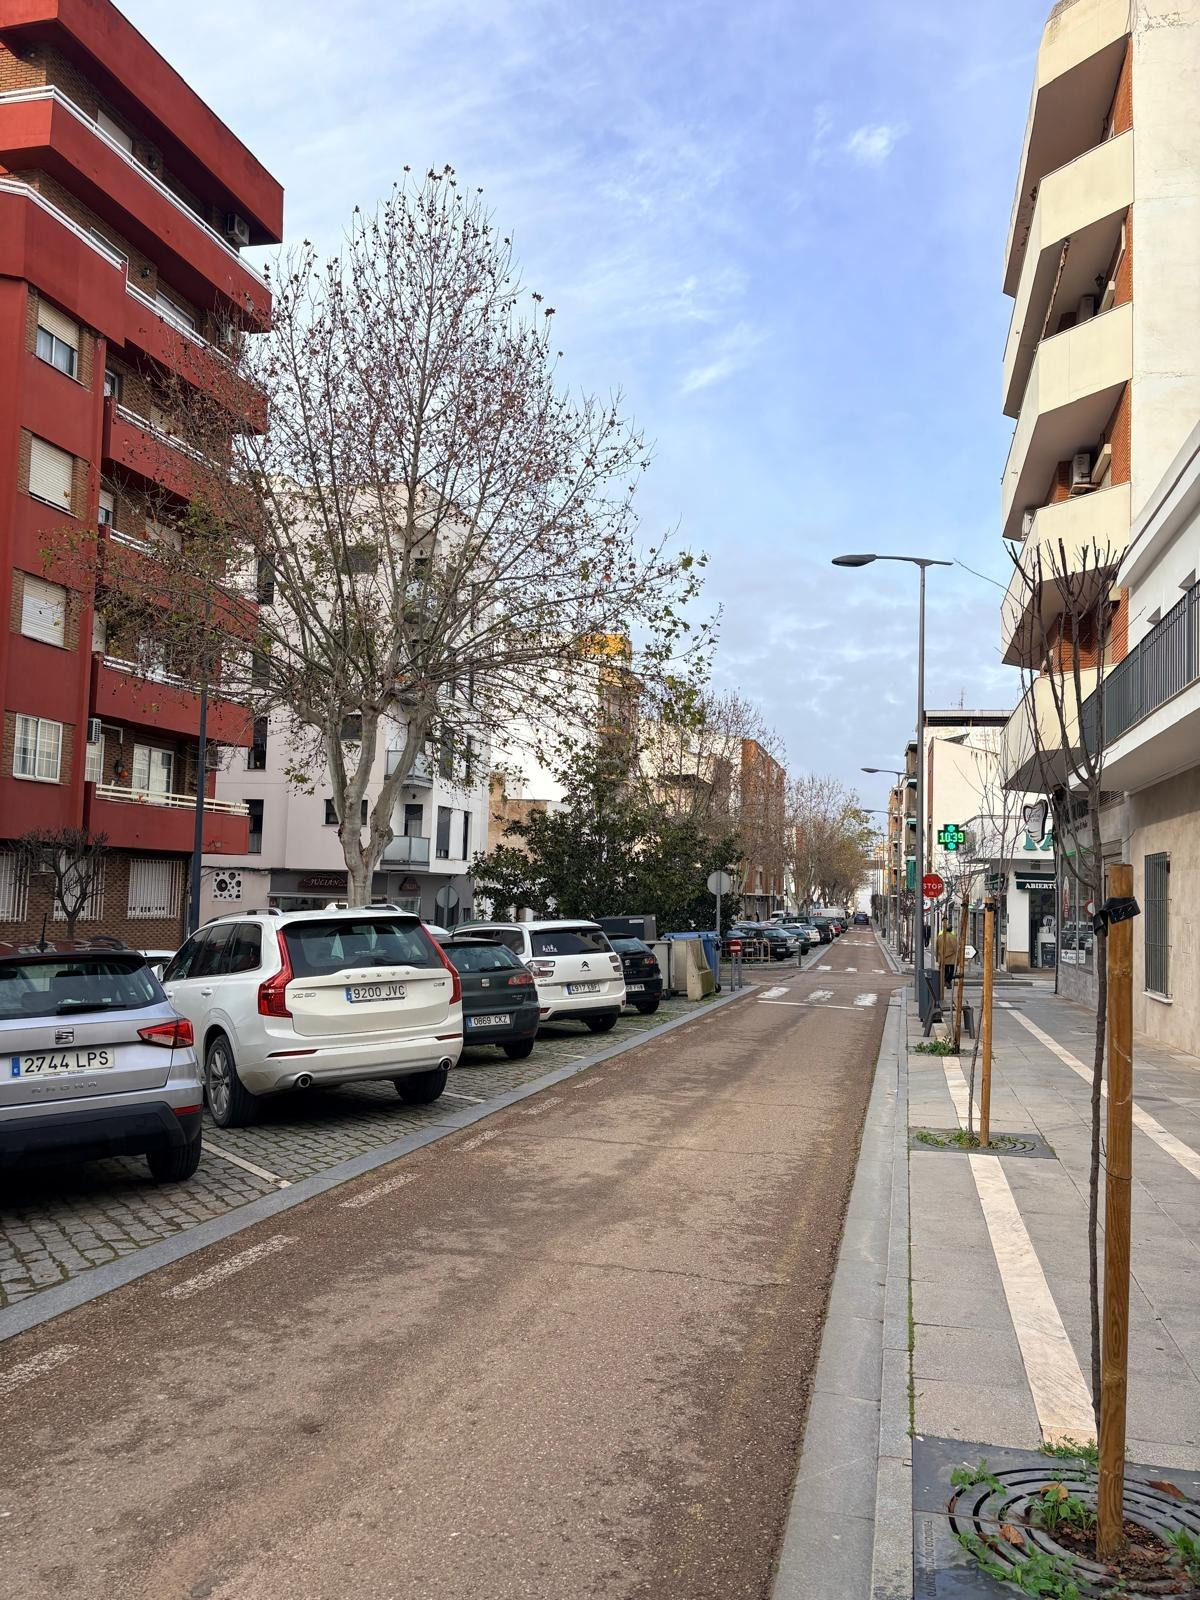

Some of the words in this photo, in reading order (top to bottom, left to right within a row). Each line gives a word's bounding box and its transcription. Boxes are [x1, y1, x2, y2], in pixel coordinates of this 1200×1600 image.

[939, 832, 964, 843] 10:39
[353, 986, 381, 998] 9200
[386, 985, 405, 996] JVC
[25, 1054, 69, 1073] 2744
[76, 1051, 108, 1068] LPS
